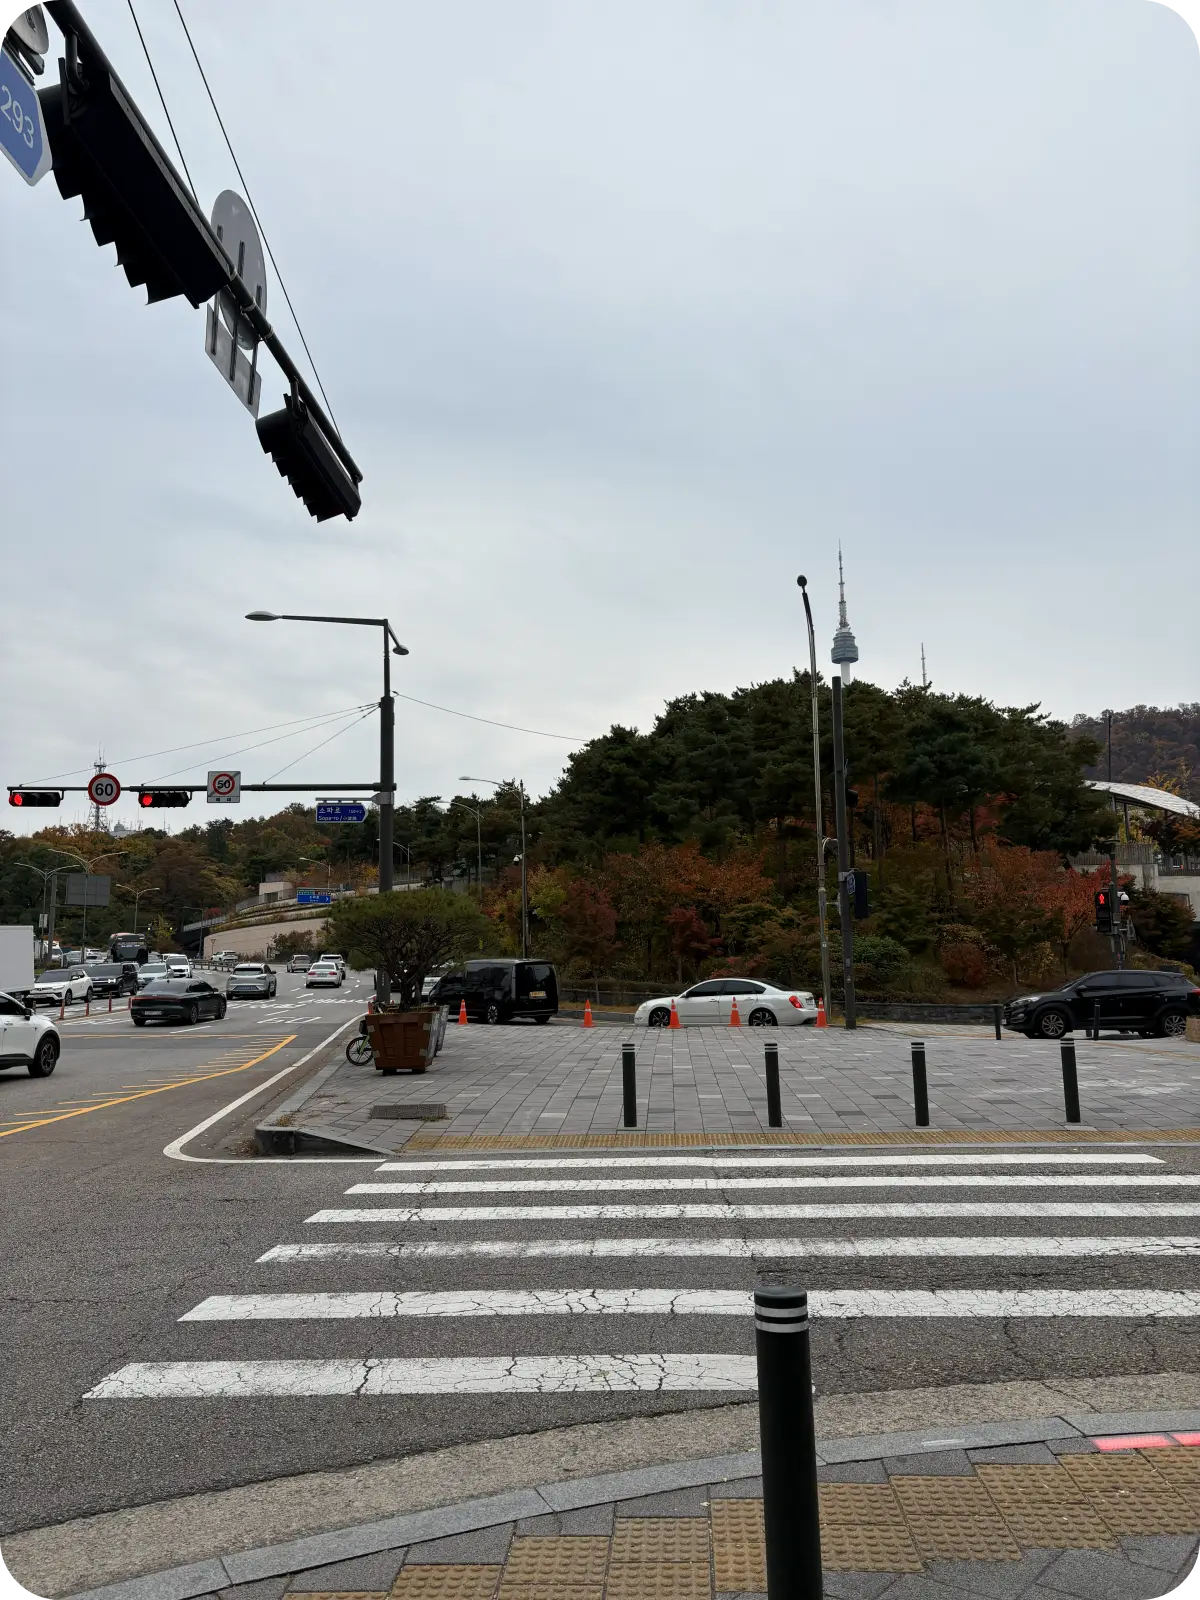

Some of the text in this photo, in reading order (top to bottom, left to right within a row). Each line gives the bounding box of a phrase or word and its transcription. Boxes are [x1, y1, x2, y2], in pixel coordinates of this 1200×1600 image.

[0, 85, 35, 149] 293
[95, 783, 114, 797] 60
[217, 780, 231, 789] 50
[318, 806, 341, 814] 소파로
